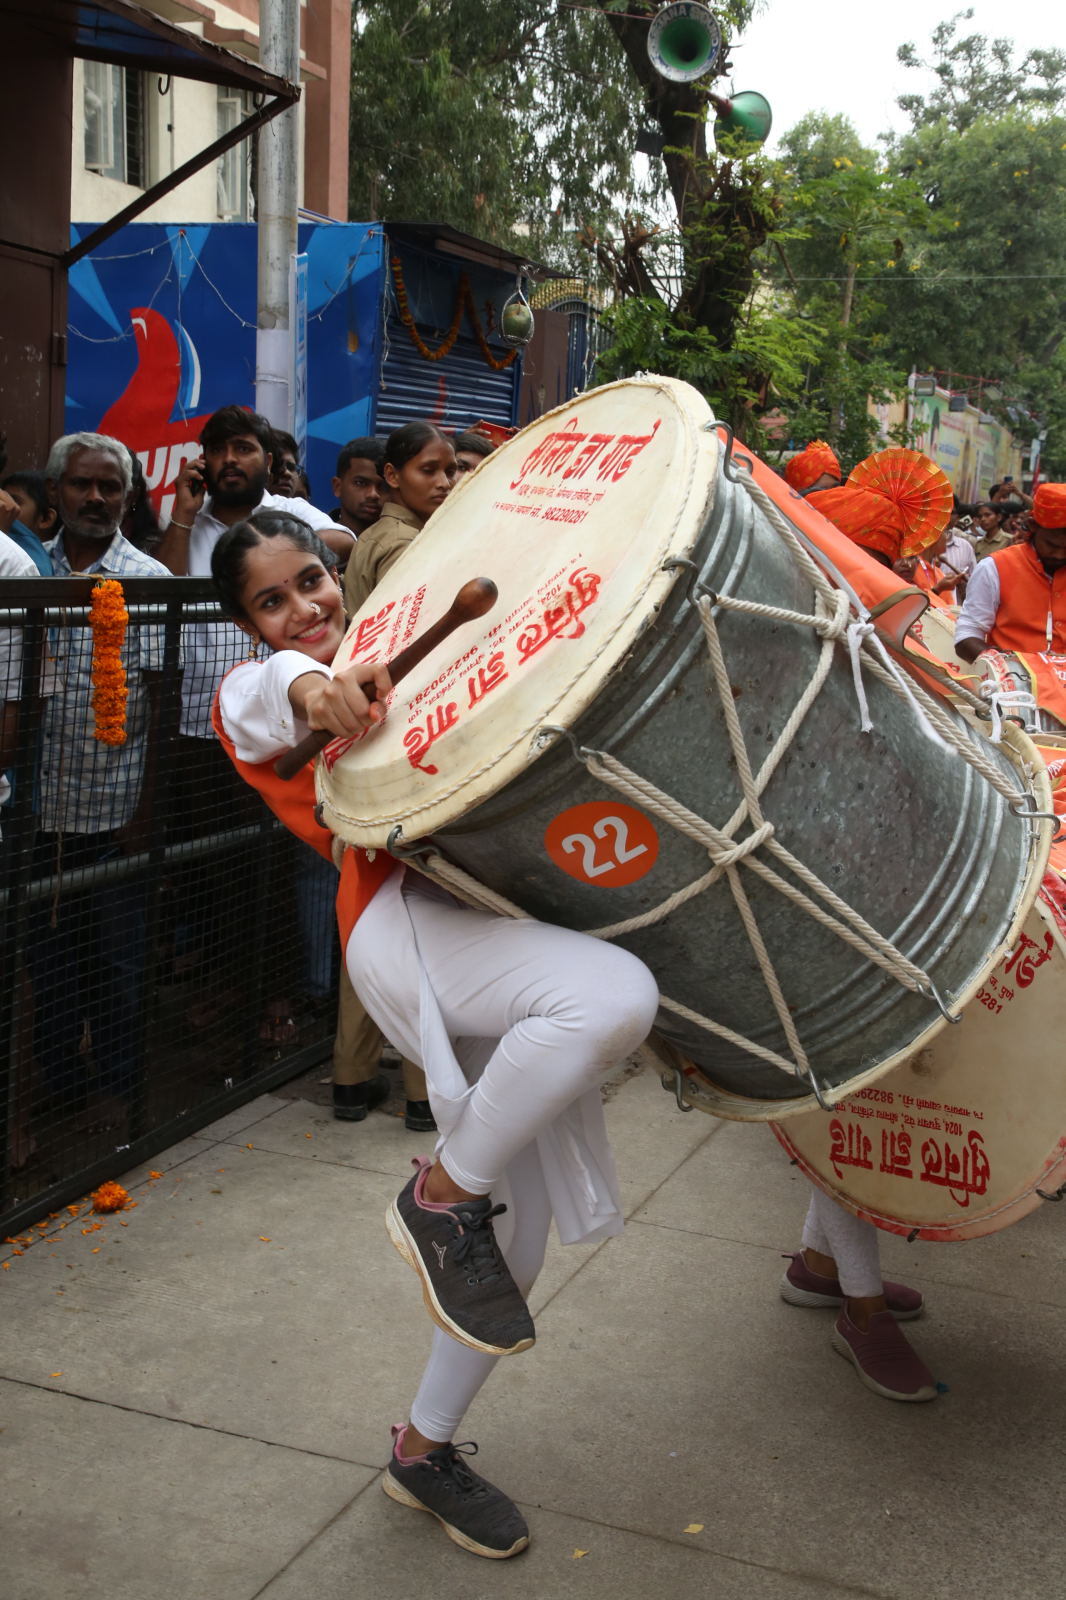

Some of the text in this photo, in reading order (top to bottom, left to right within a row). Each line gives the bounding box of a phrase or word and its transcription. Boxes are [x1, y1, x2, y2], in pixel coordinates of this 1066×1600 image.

[542, 507, 588, 524] 982290281
[411, 646, 477, 709] 982290281
[562, 816, 648, 878] 22
[830, 1119, 874, 1179] गाडे
[920, 1131, 990, 1206] सुनिल
